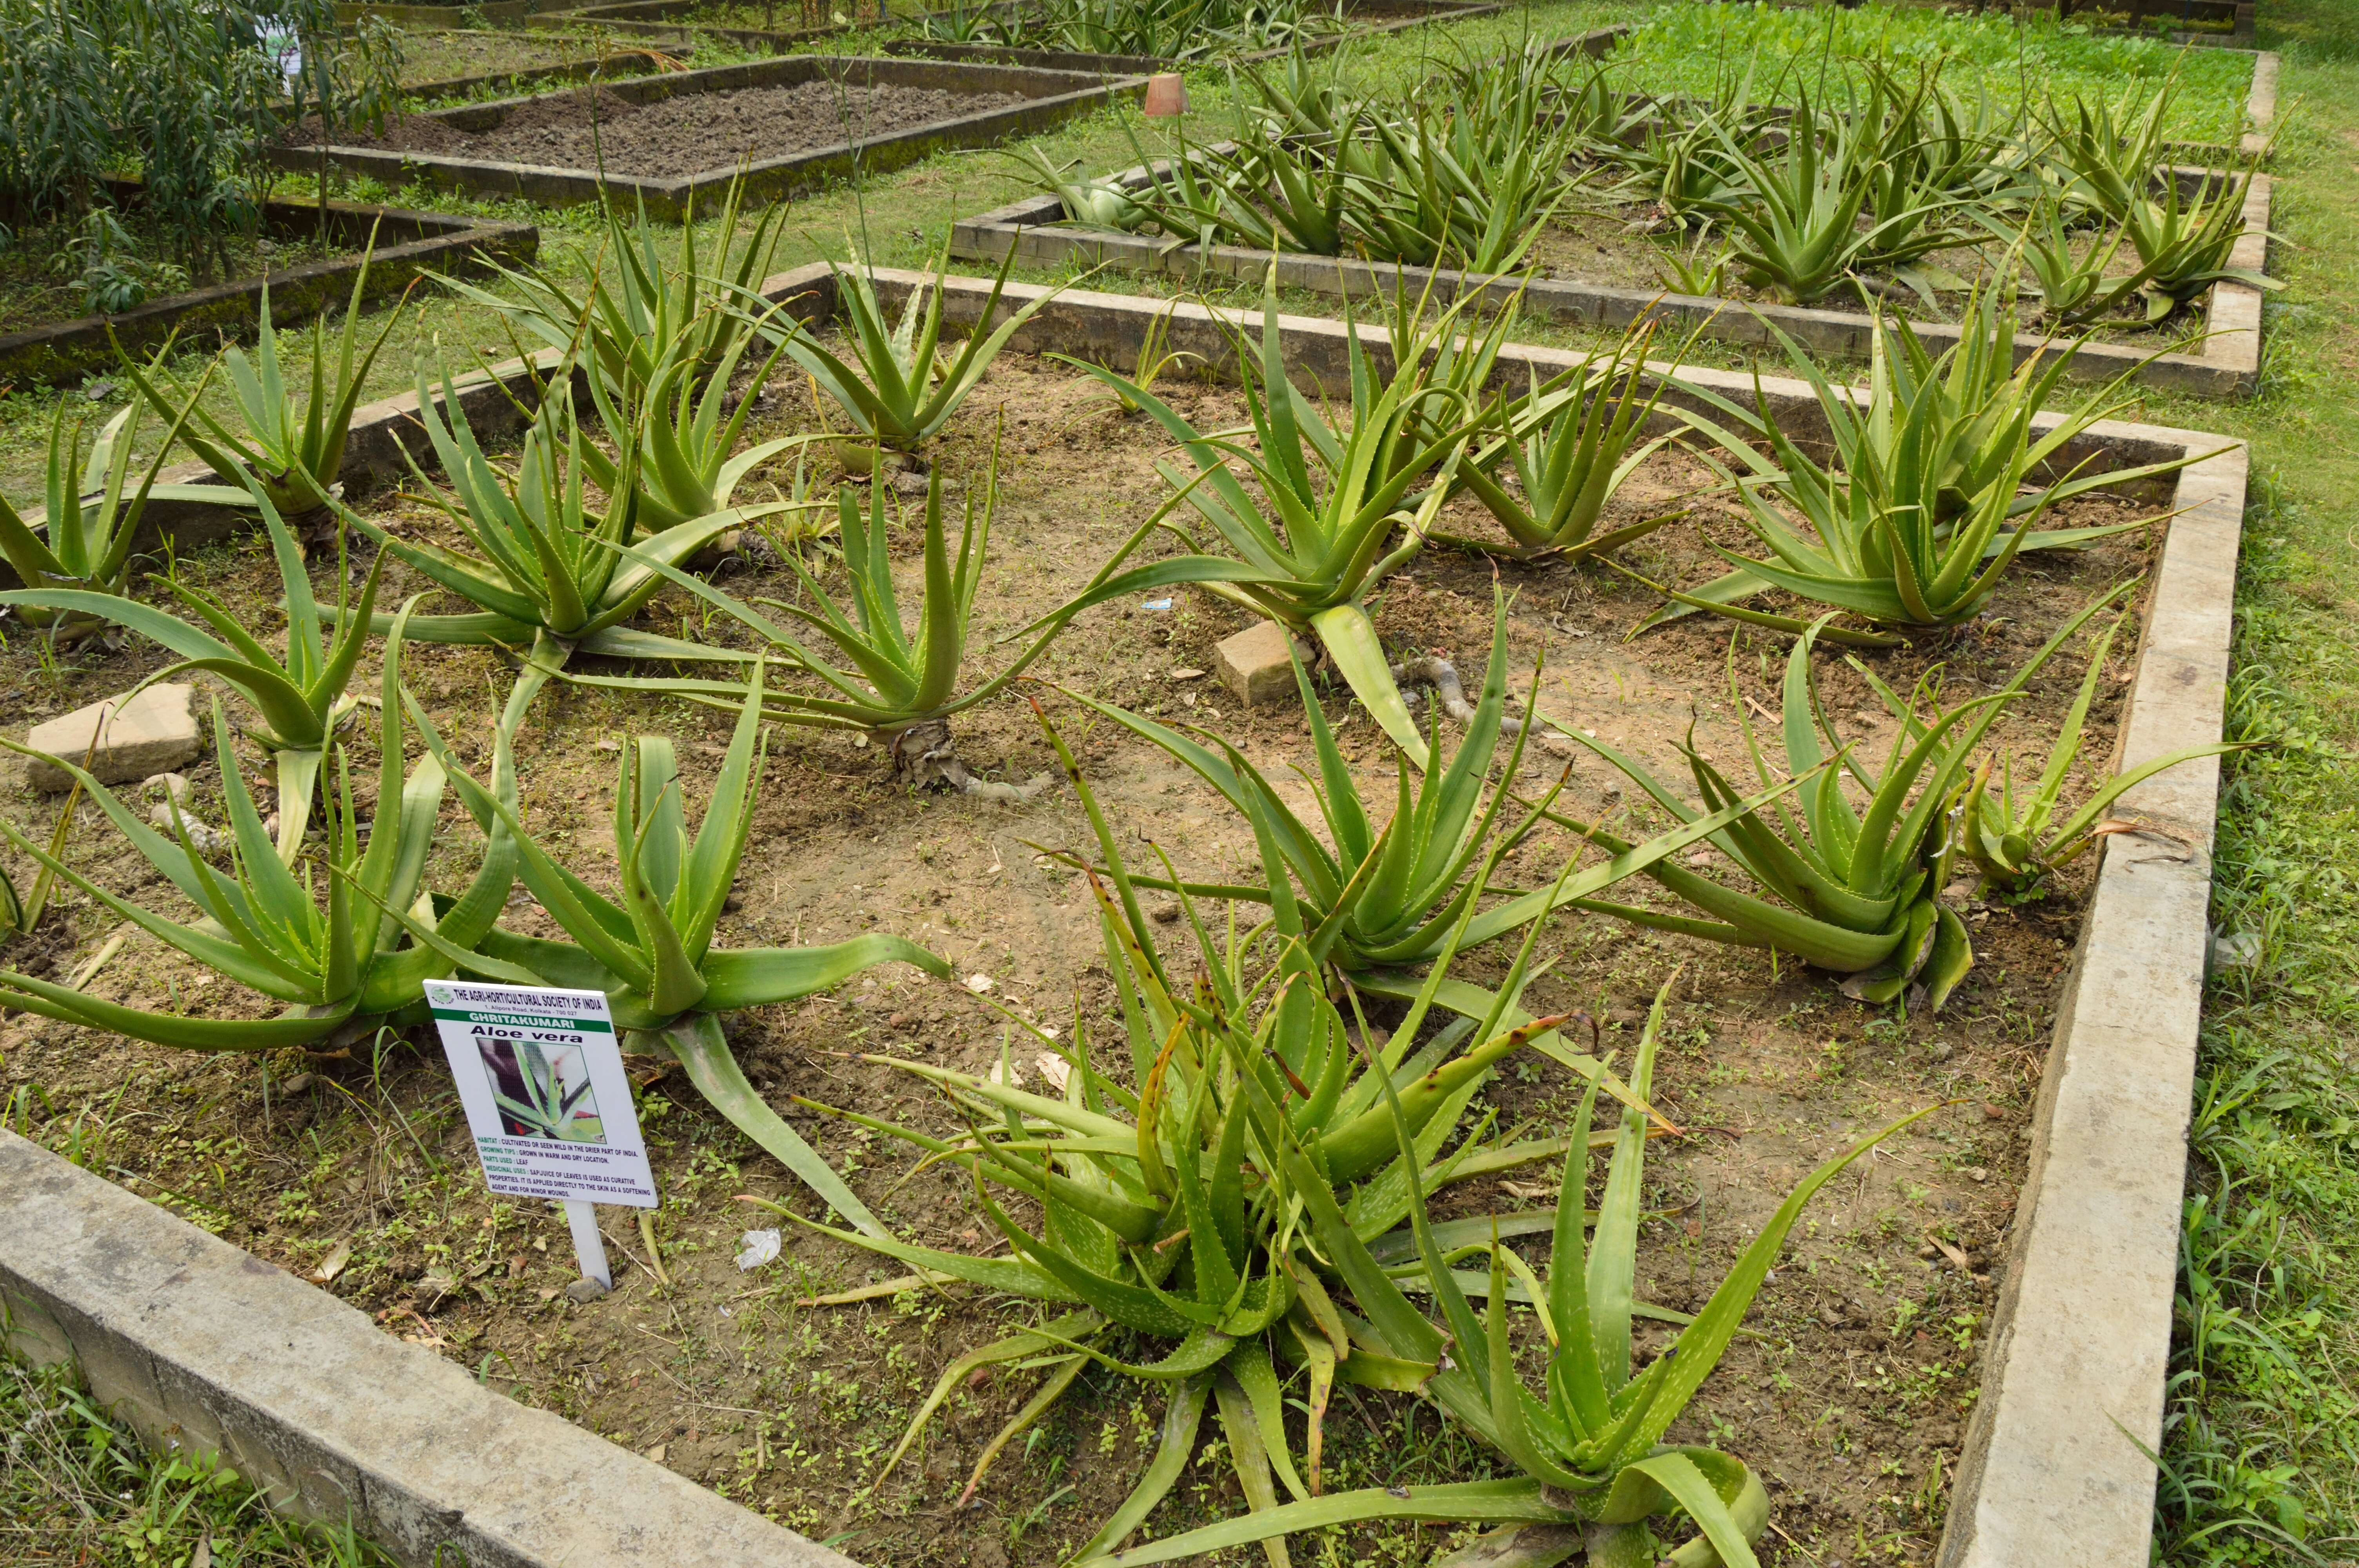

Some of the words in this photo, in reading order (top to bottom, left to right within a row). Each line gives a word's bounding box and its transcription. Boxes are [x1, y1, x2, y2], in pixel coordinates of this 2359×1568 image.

[454, 989, 469, 1000] THE
[470, 990, 542, 1006] AGRI-HORTICULTURAL
[542, 995, 571, 1008] SOCIETY
[572, 998, 581, 1009] OF
[582, 998, 603, 1011] INDIA
[469, 1013, 575, 1029] GHRITAKUMARI
[470, 1025, 523, 1038] Aloe
[532, 1032, 583, 1043] vera
[489, 1174, 520, 1183] PROPERTIES.
